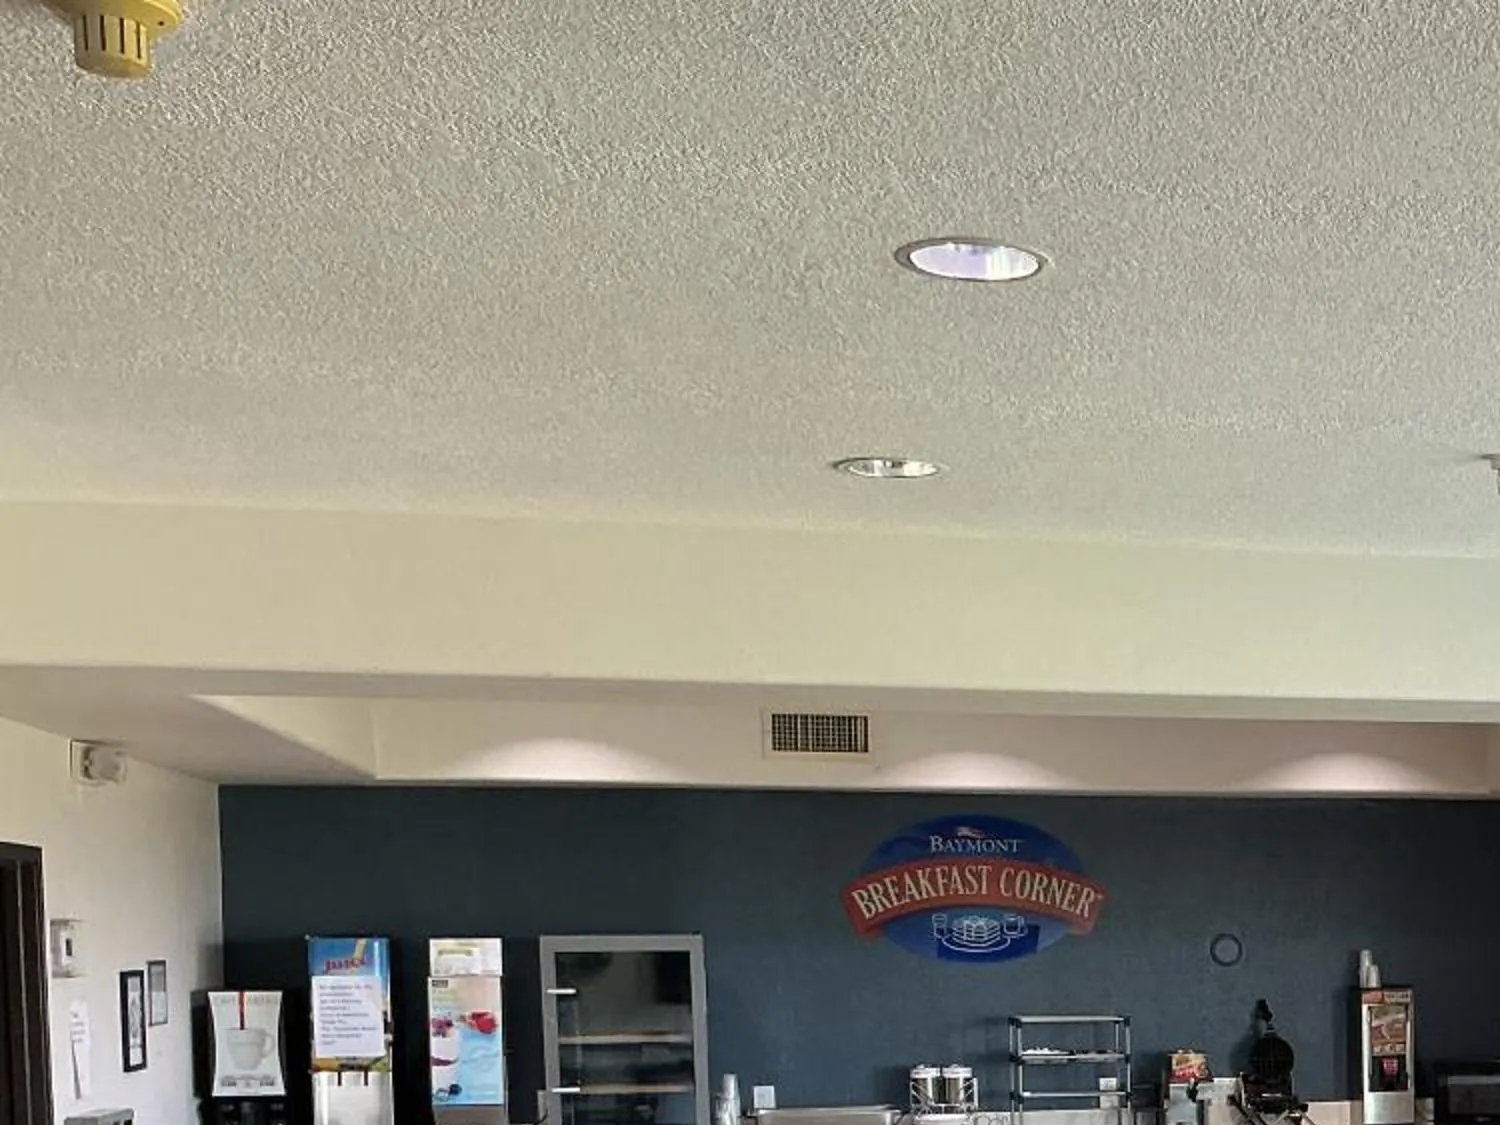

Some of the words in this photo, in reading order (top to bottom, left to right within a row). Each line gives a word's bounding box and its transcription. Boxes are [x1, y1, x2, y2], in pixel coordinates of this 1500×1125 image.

[929, 836, 1020, 854] BAYMONT
[851, 865, 993, 920] BREAKFAST
[999, 867, 1097, 919] CORNER
